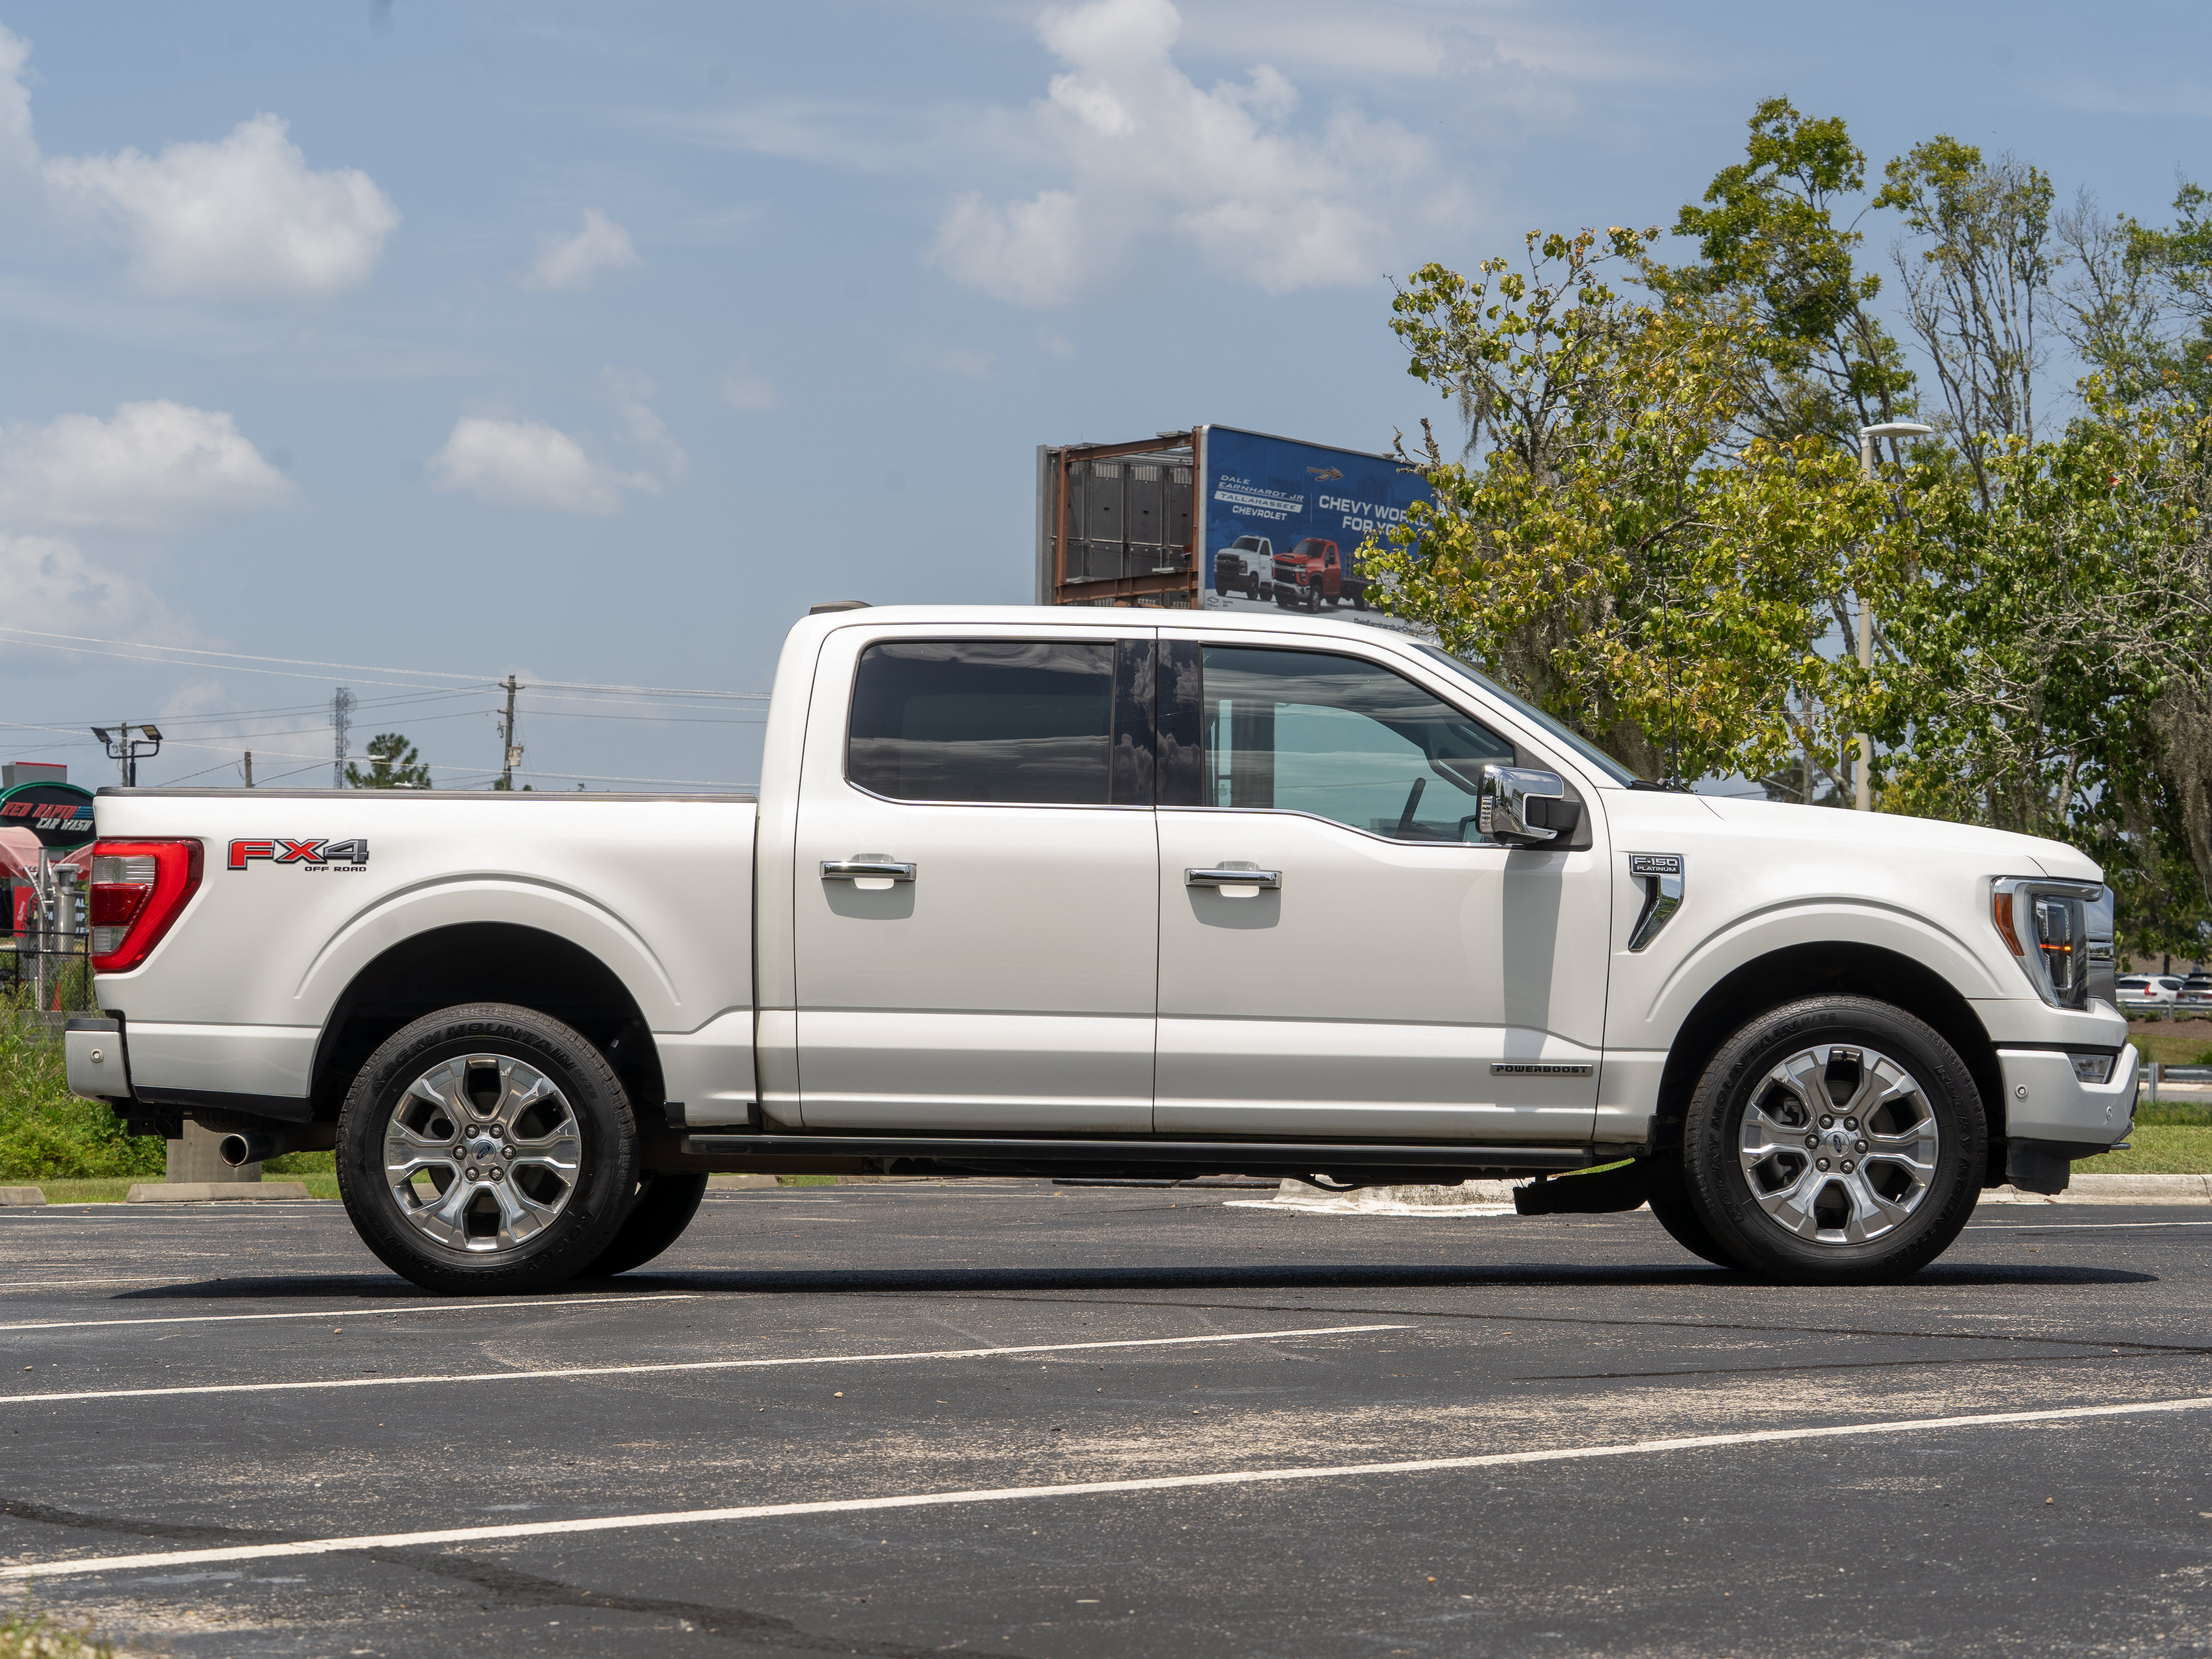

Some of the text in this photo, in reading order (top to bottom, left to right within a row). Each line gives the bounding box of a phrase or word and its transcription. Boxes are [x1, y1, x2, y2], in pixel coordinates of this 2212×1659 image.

[1220, 474, 1251, 485] DALE
[1218, 482, 1287, 498] EARNHARDT
[1220, 492, 1297, 511] TALLAHASSEE
[1319, 495, 1372, 516] CHEVY
[1232, 506, 1287, 521] CHEVROLET
[1343, 516, 1373, 532] FOR
[0, 802, 79, 819] RED RAPID
[36, 817, 94, 831] CAR WASH
[227, 838, 369, 871] FX4
[1634, 857, 1678, 866] F-150
[370, 1030, 443, 1097] ROCKY
[446, 1022, 577, 1070] MOUNTAIN
[1711, 1020, 1798, 1130] MOUNTAIN
